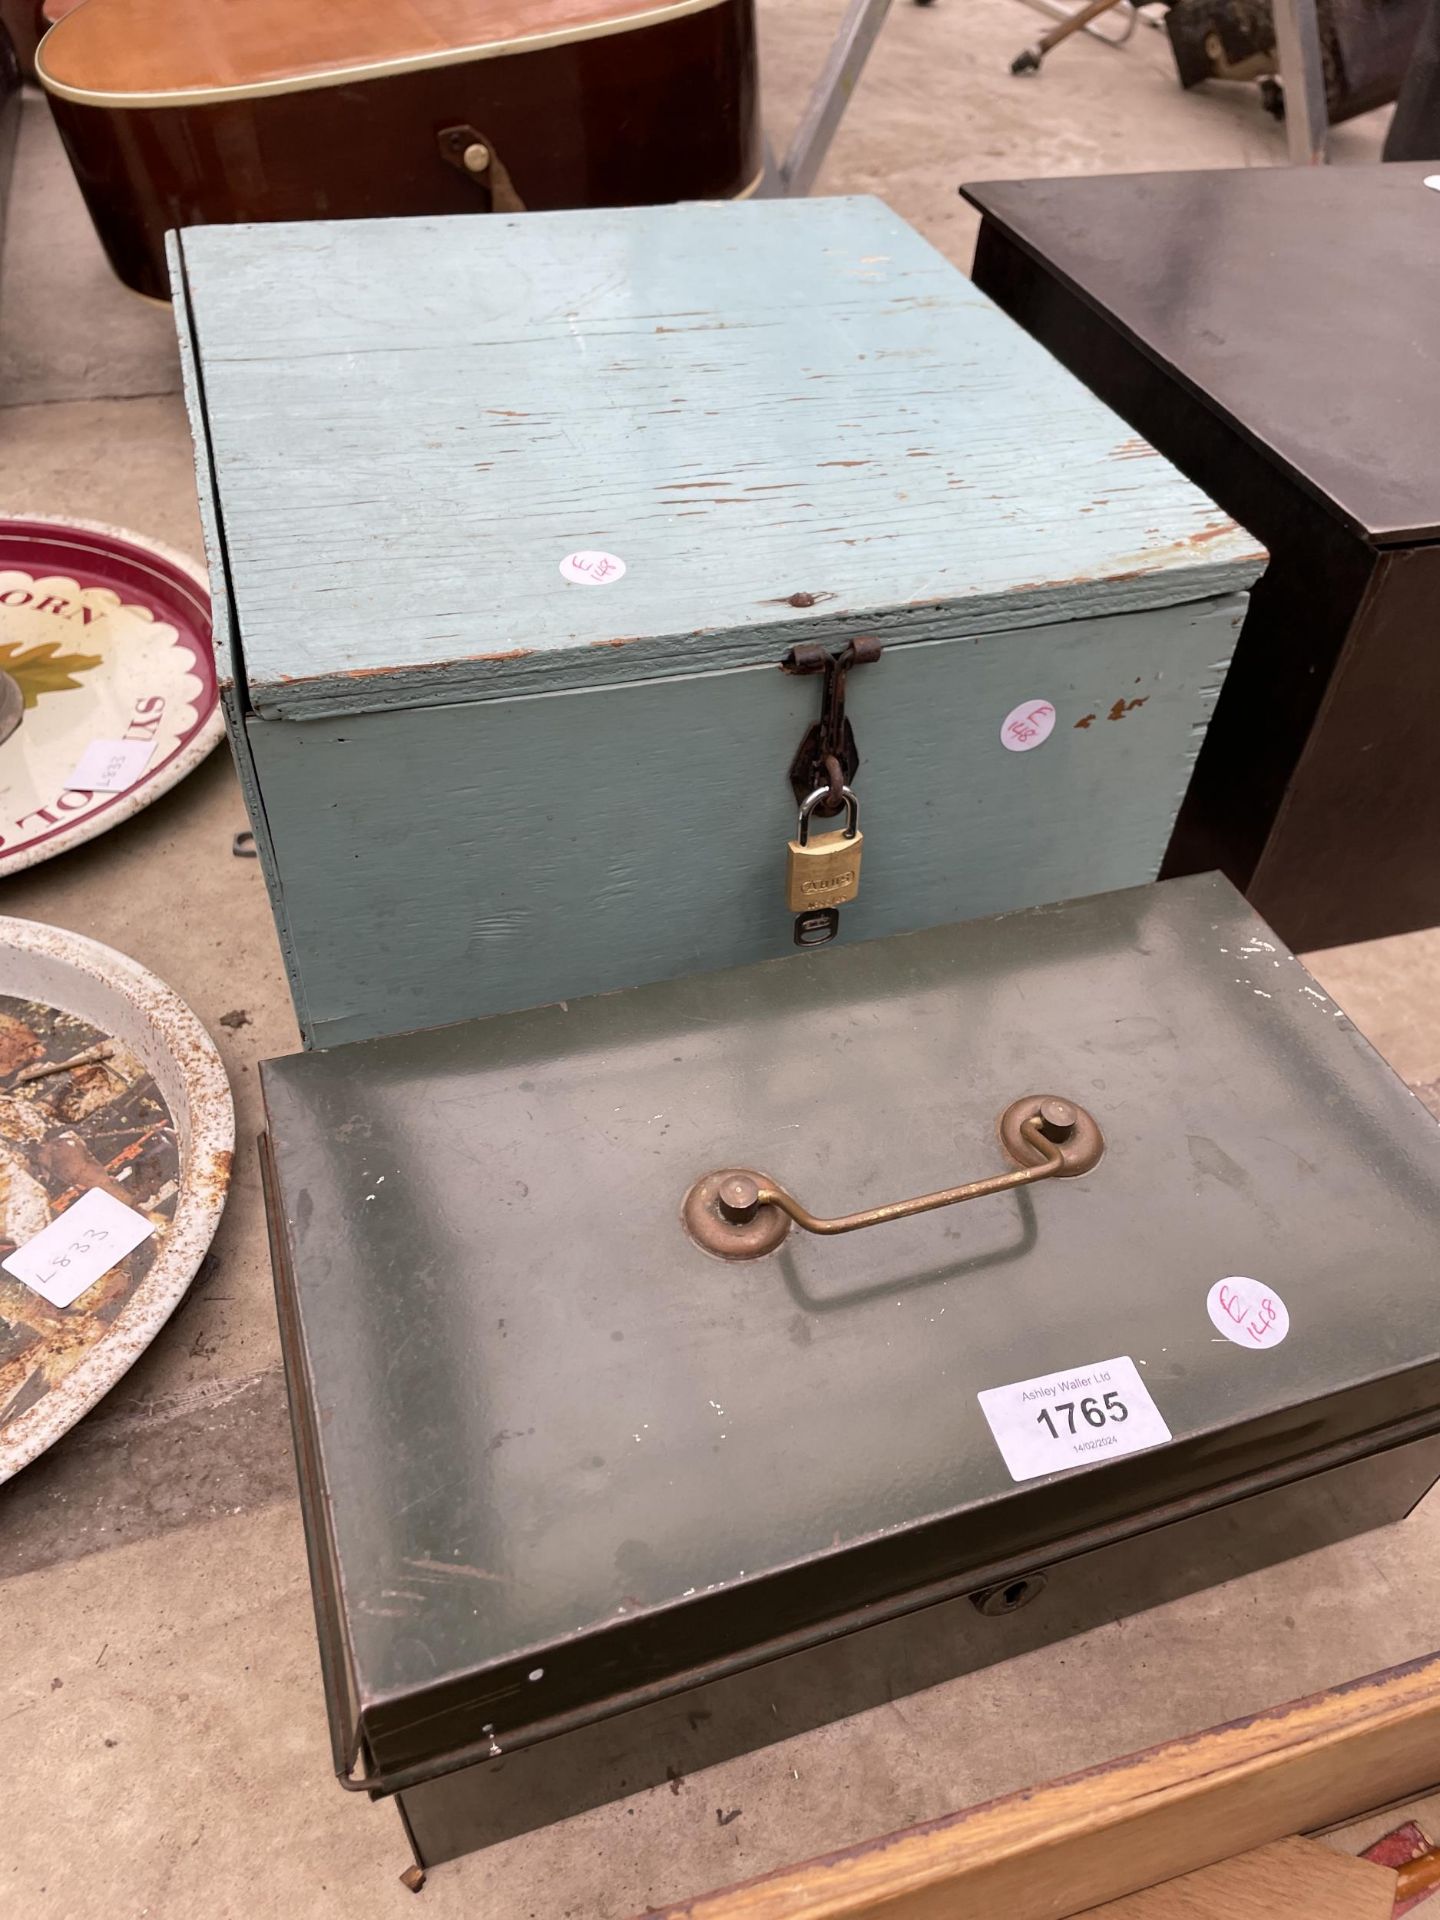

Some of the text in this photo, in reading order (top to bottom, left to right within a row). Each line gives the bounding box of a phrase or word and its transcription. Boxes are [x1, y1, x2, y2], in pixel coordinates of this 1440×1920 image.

[15, 696, 166, 830] SYOL
[36, 1229, 109, 1284] L833
[1021, 1370, 1112, 1403] Ashley Waller Ltd
[1036, 1391, 1128, 1439] 1765
[1073, 1435, 1118, 1453] 14/02/2024
